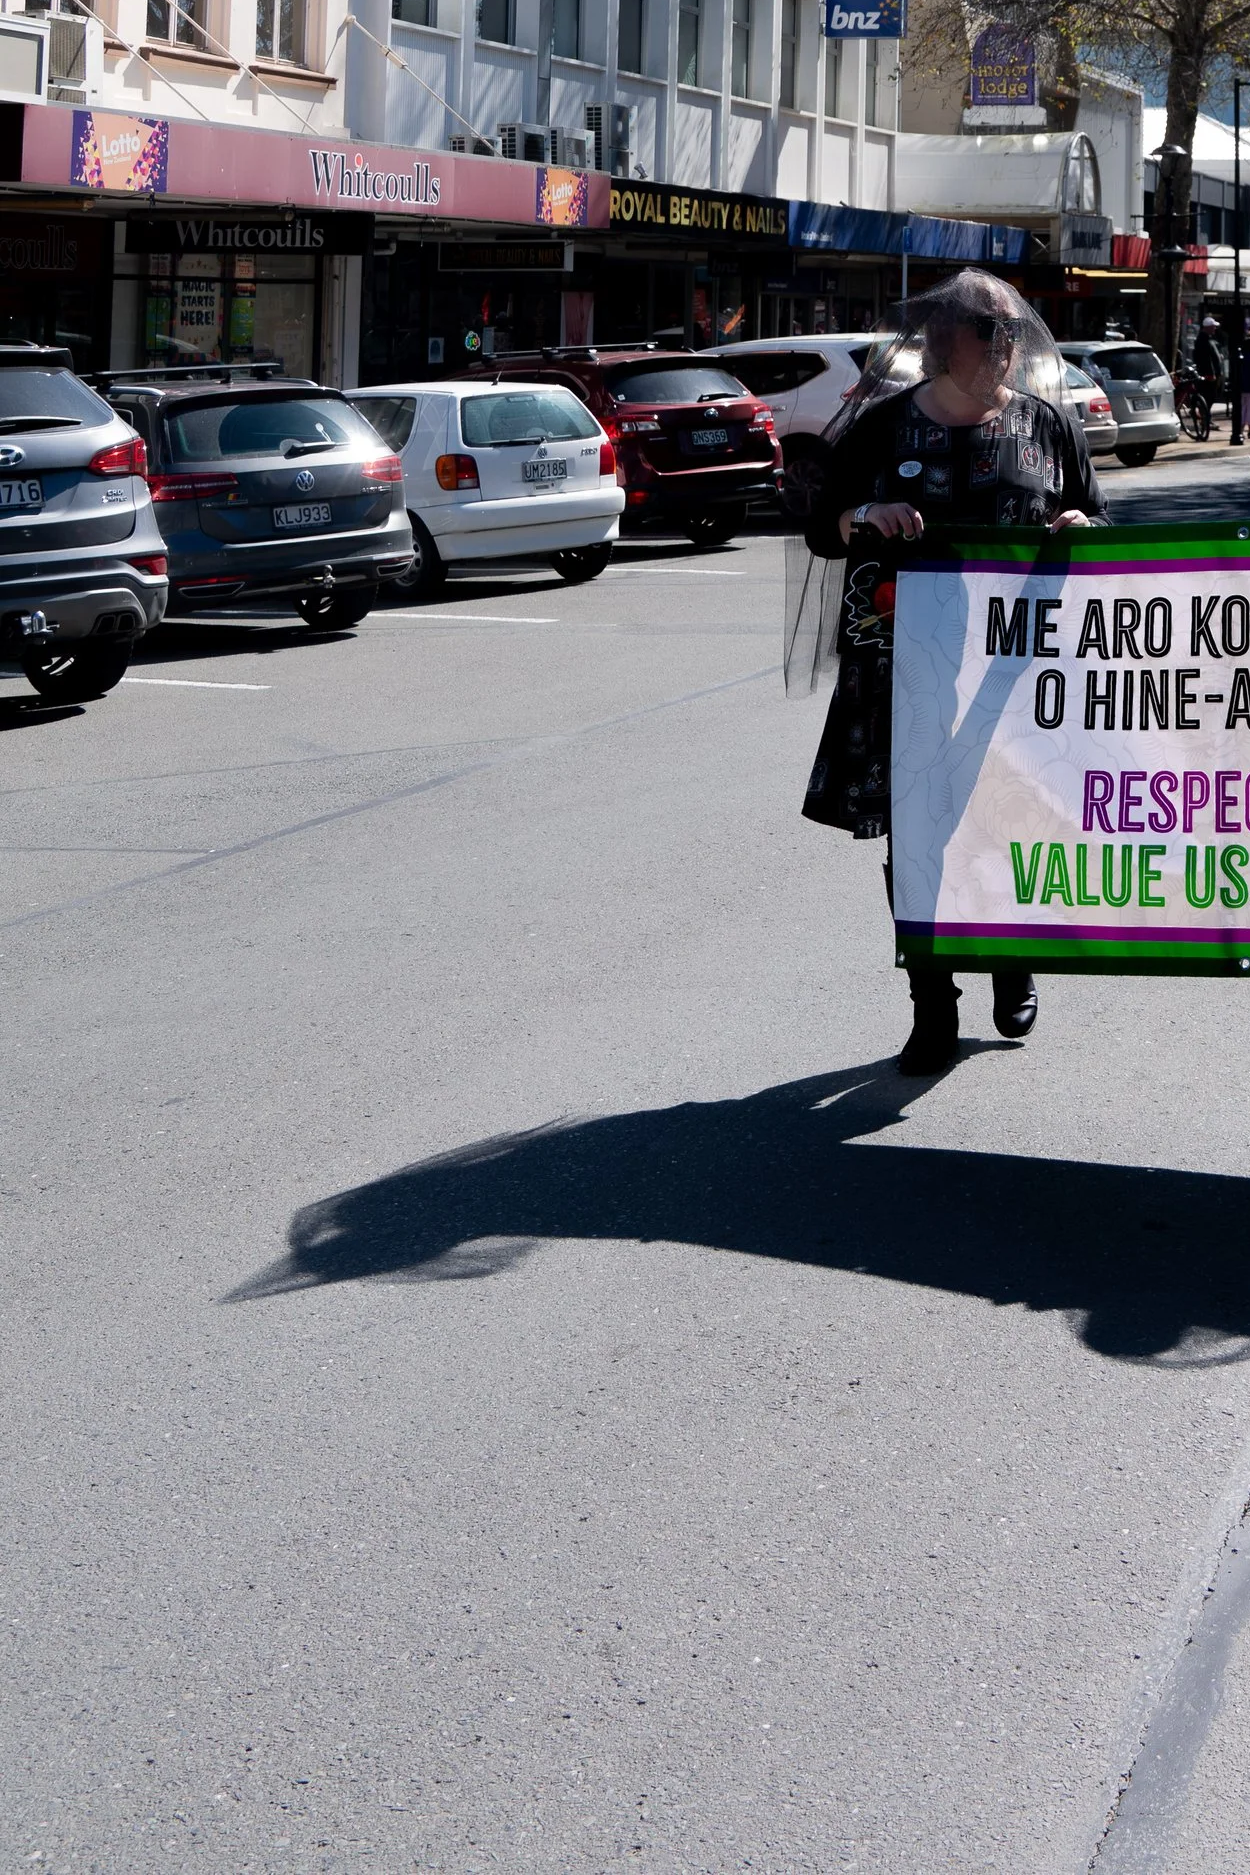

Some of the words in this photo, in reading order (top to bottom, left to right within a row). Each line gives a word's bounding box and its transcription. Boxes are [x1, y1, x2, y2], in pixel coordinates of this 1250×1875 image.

[830, 4, 881, 30] bnz
[979, 77, 1028, 99] lodge
[102, 132, 141, 158] Lotto
[309, 149, 441, 205] Whitcoulls
[552, 182, 573, 201] Lotto
[609, 189, 666, 224] ROYAL
[669, 195, 730, 230] BEAUTY
[732, 204, 743, 232] &
[746, 206, 786, 236] NAILS
[176, 218, 325, 249] Whitcoulls
[182, 281, 217, 293] MAGIC
[181, 296, 216, 308] STARTS
[181, 310, 216, 326] HERE!
[525, 462, 566, 479] UM2185
[0, 482, 41, 503] 716
[274, 505, 331, 526] KLJ933
[985, 596, 1062, 657] ME
[1075, 596, 1173, 660] ARO
[1034, 669, 1066, 730] O
[1010, 841, 1168, 909] VALUE
